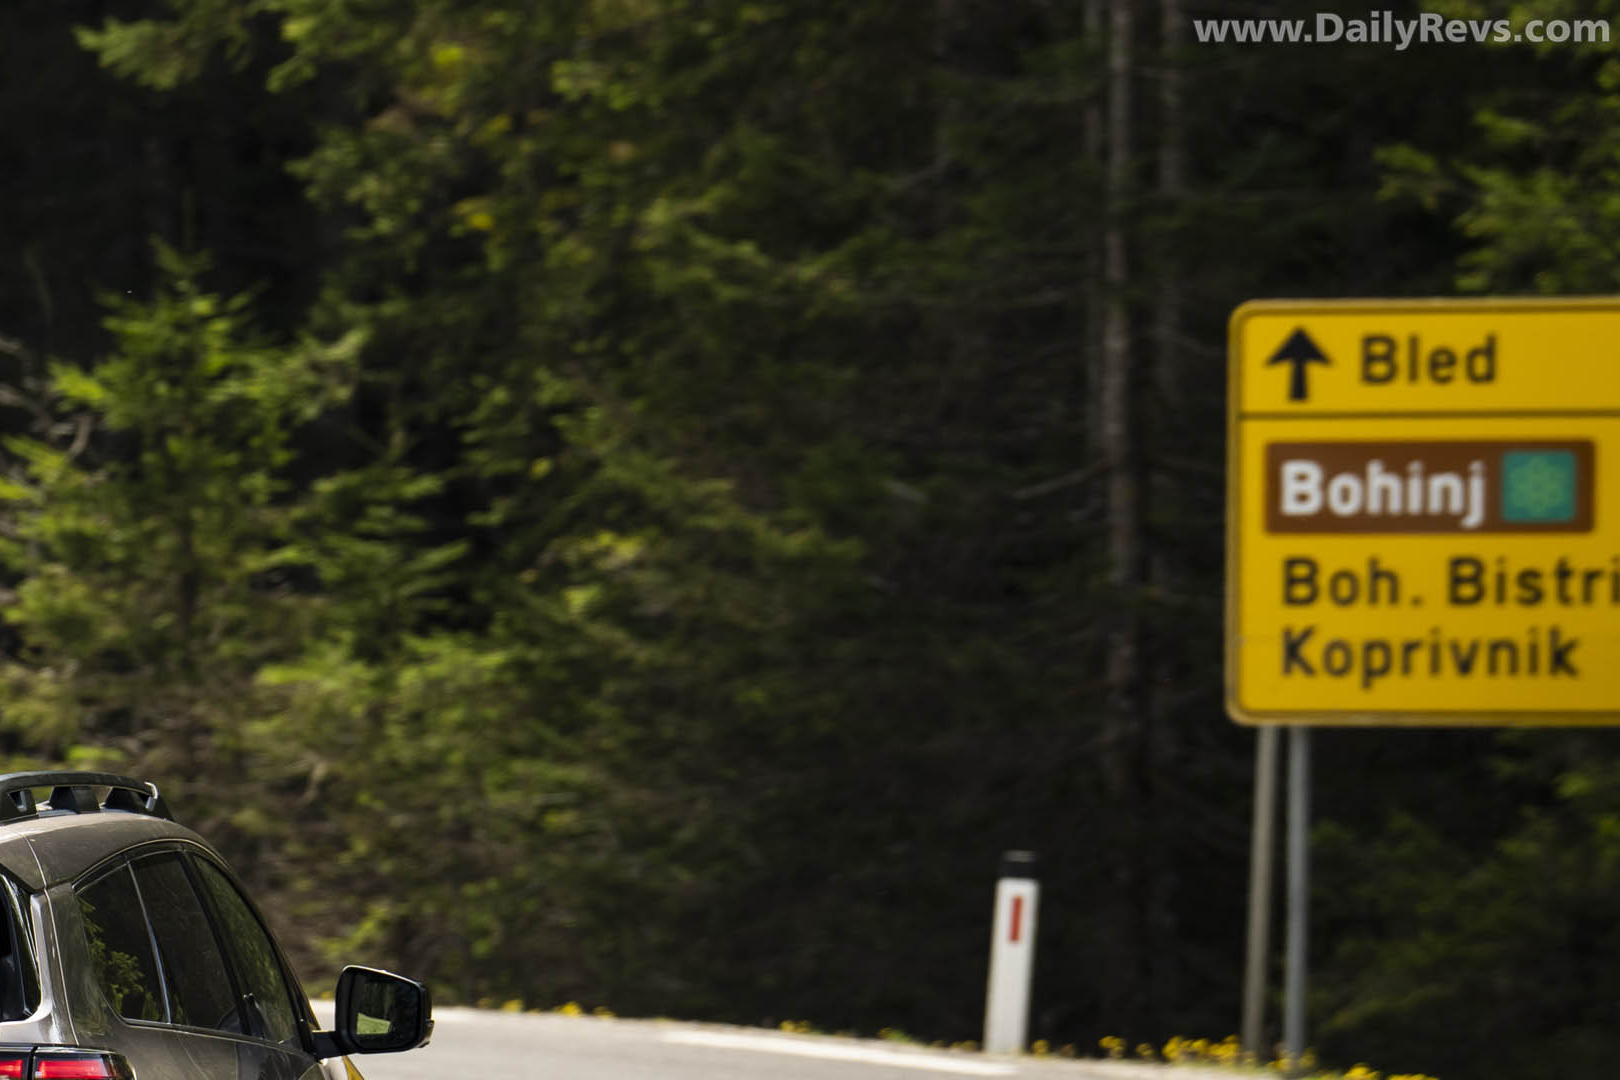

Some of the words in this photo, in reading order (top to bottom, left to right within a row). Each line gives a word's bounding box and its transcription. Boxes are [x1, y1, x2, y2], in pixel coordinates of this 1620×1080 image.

[1360, 334, 1498, 385] Bled
[1280, 459, 1487, 529] Bohinj
[1281, 556, 1424, 607] Boh.
[1281, 625, 1581, 690] Koprivnik
